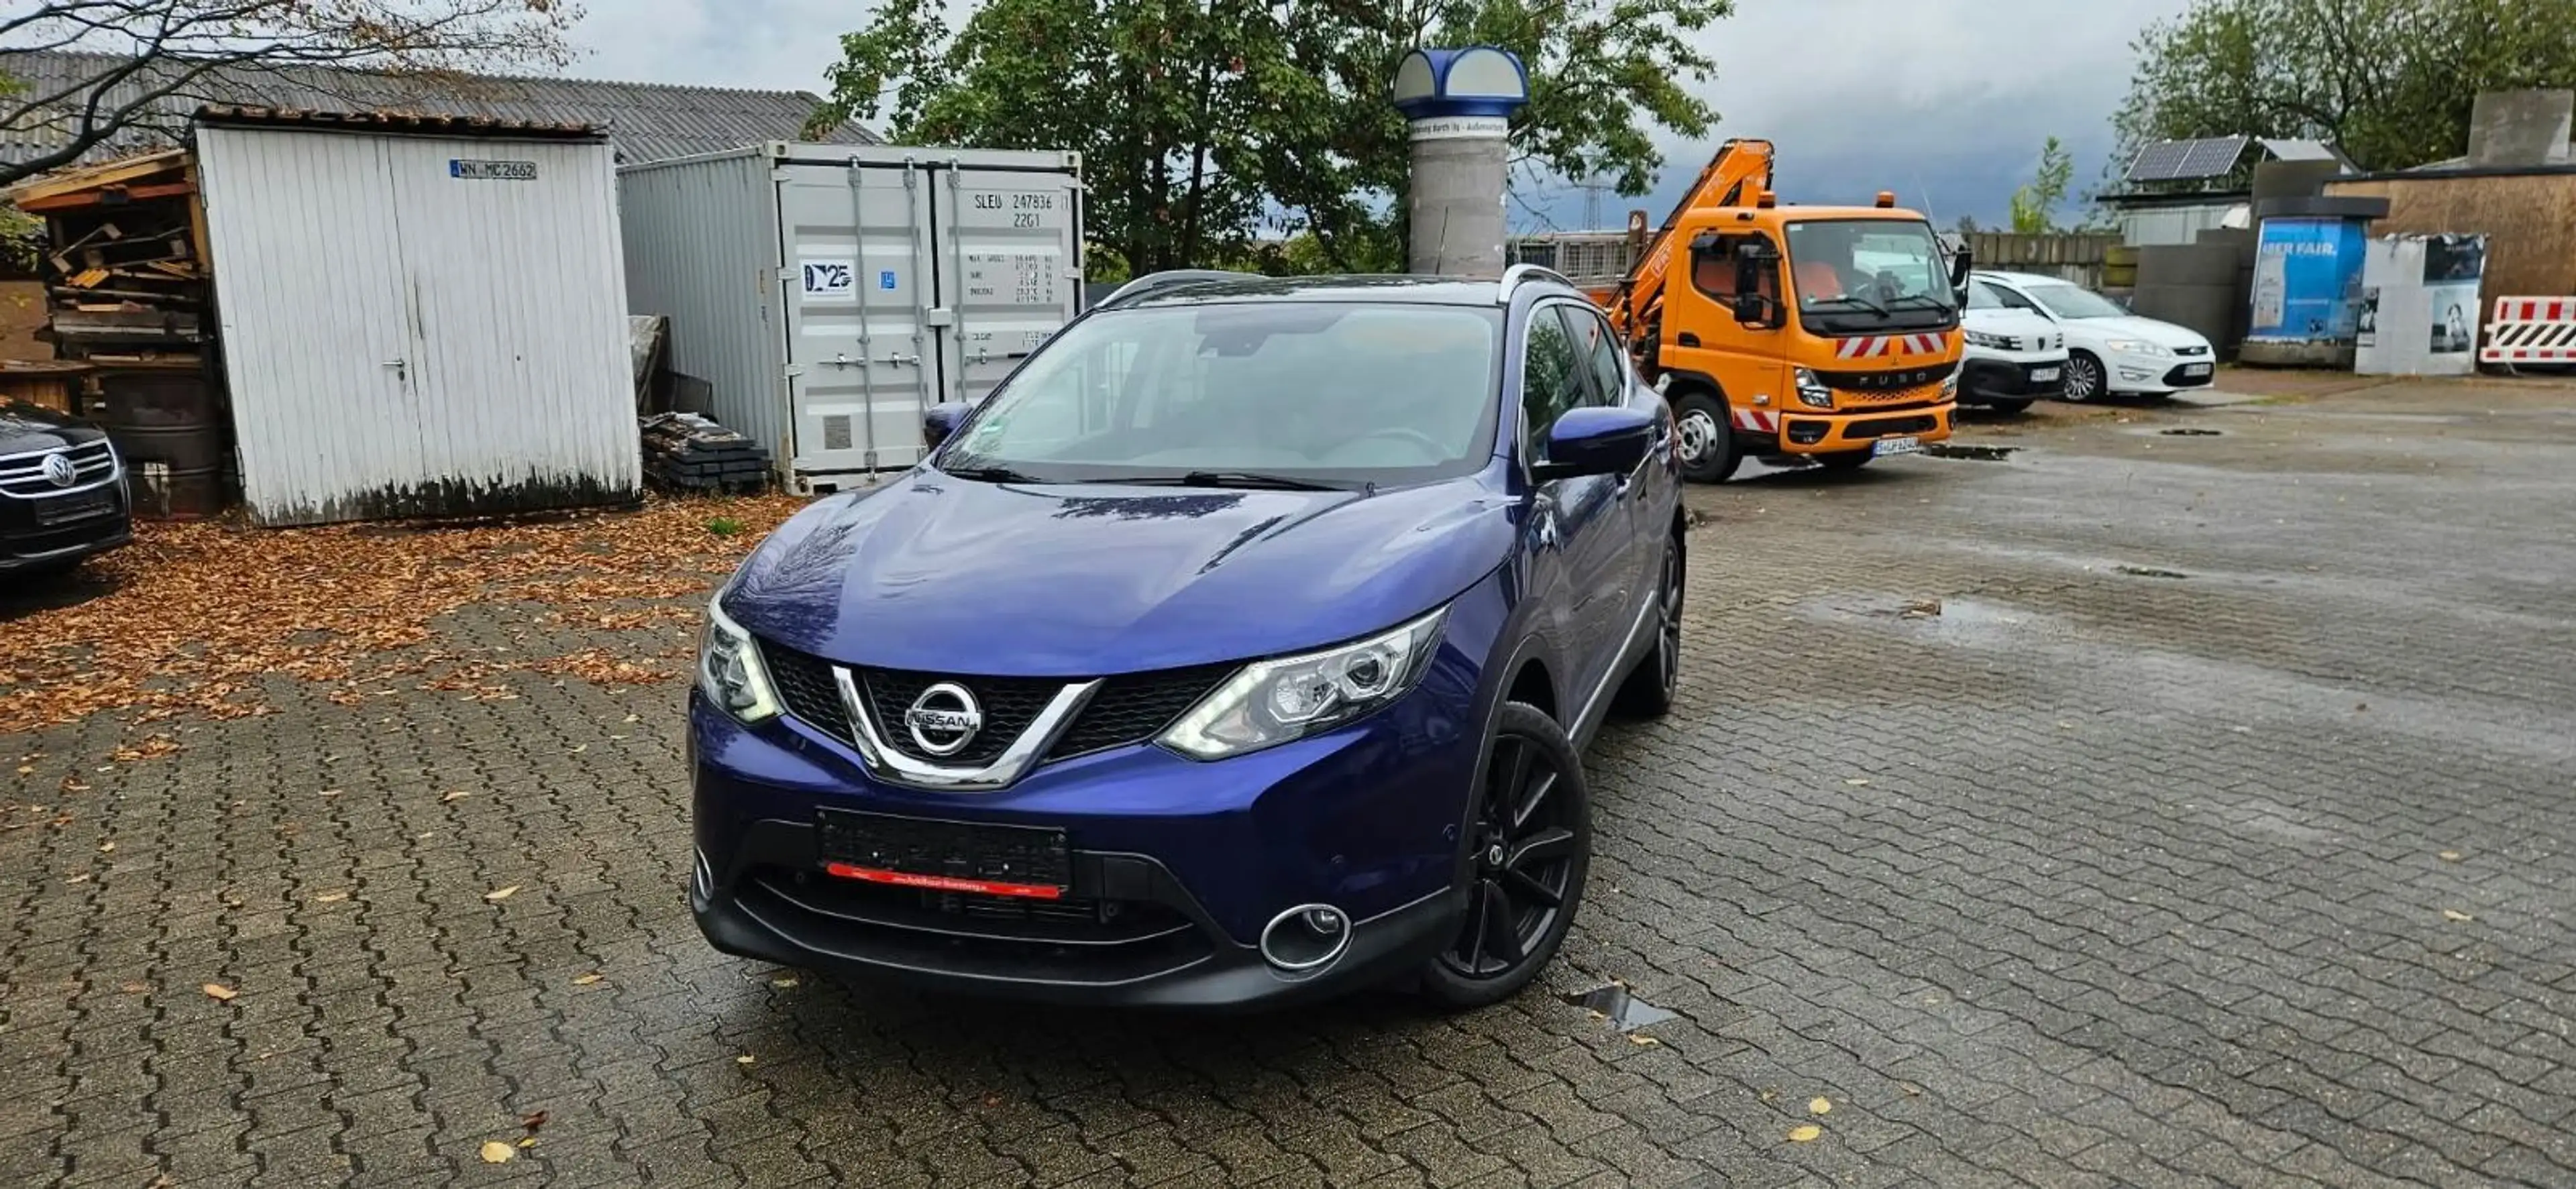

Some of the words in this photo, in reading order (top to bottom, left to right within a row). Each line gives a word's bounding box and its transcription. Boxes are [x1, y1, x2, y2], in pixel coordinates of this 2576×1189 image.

[460, 162, 476, 175] WN
[975, 194, 1002, 209] SLEU
[1014, 213, 1040, 228] 22G1
[1859, 372, 1927, 387] FUSO
[914, 712, 971, 727] NISSAN
